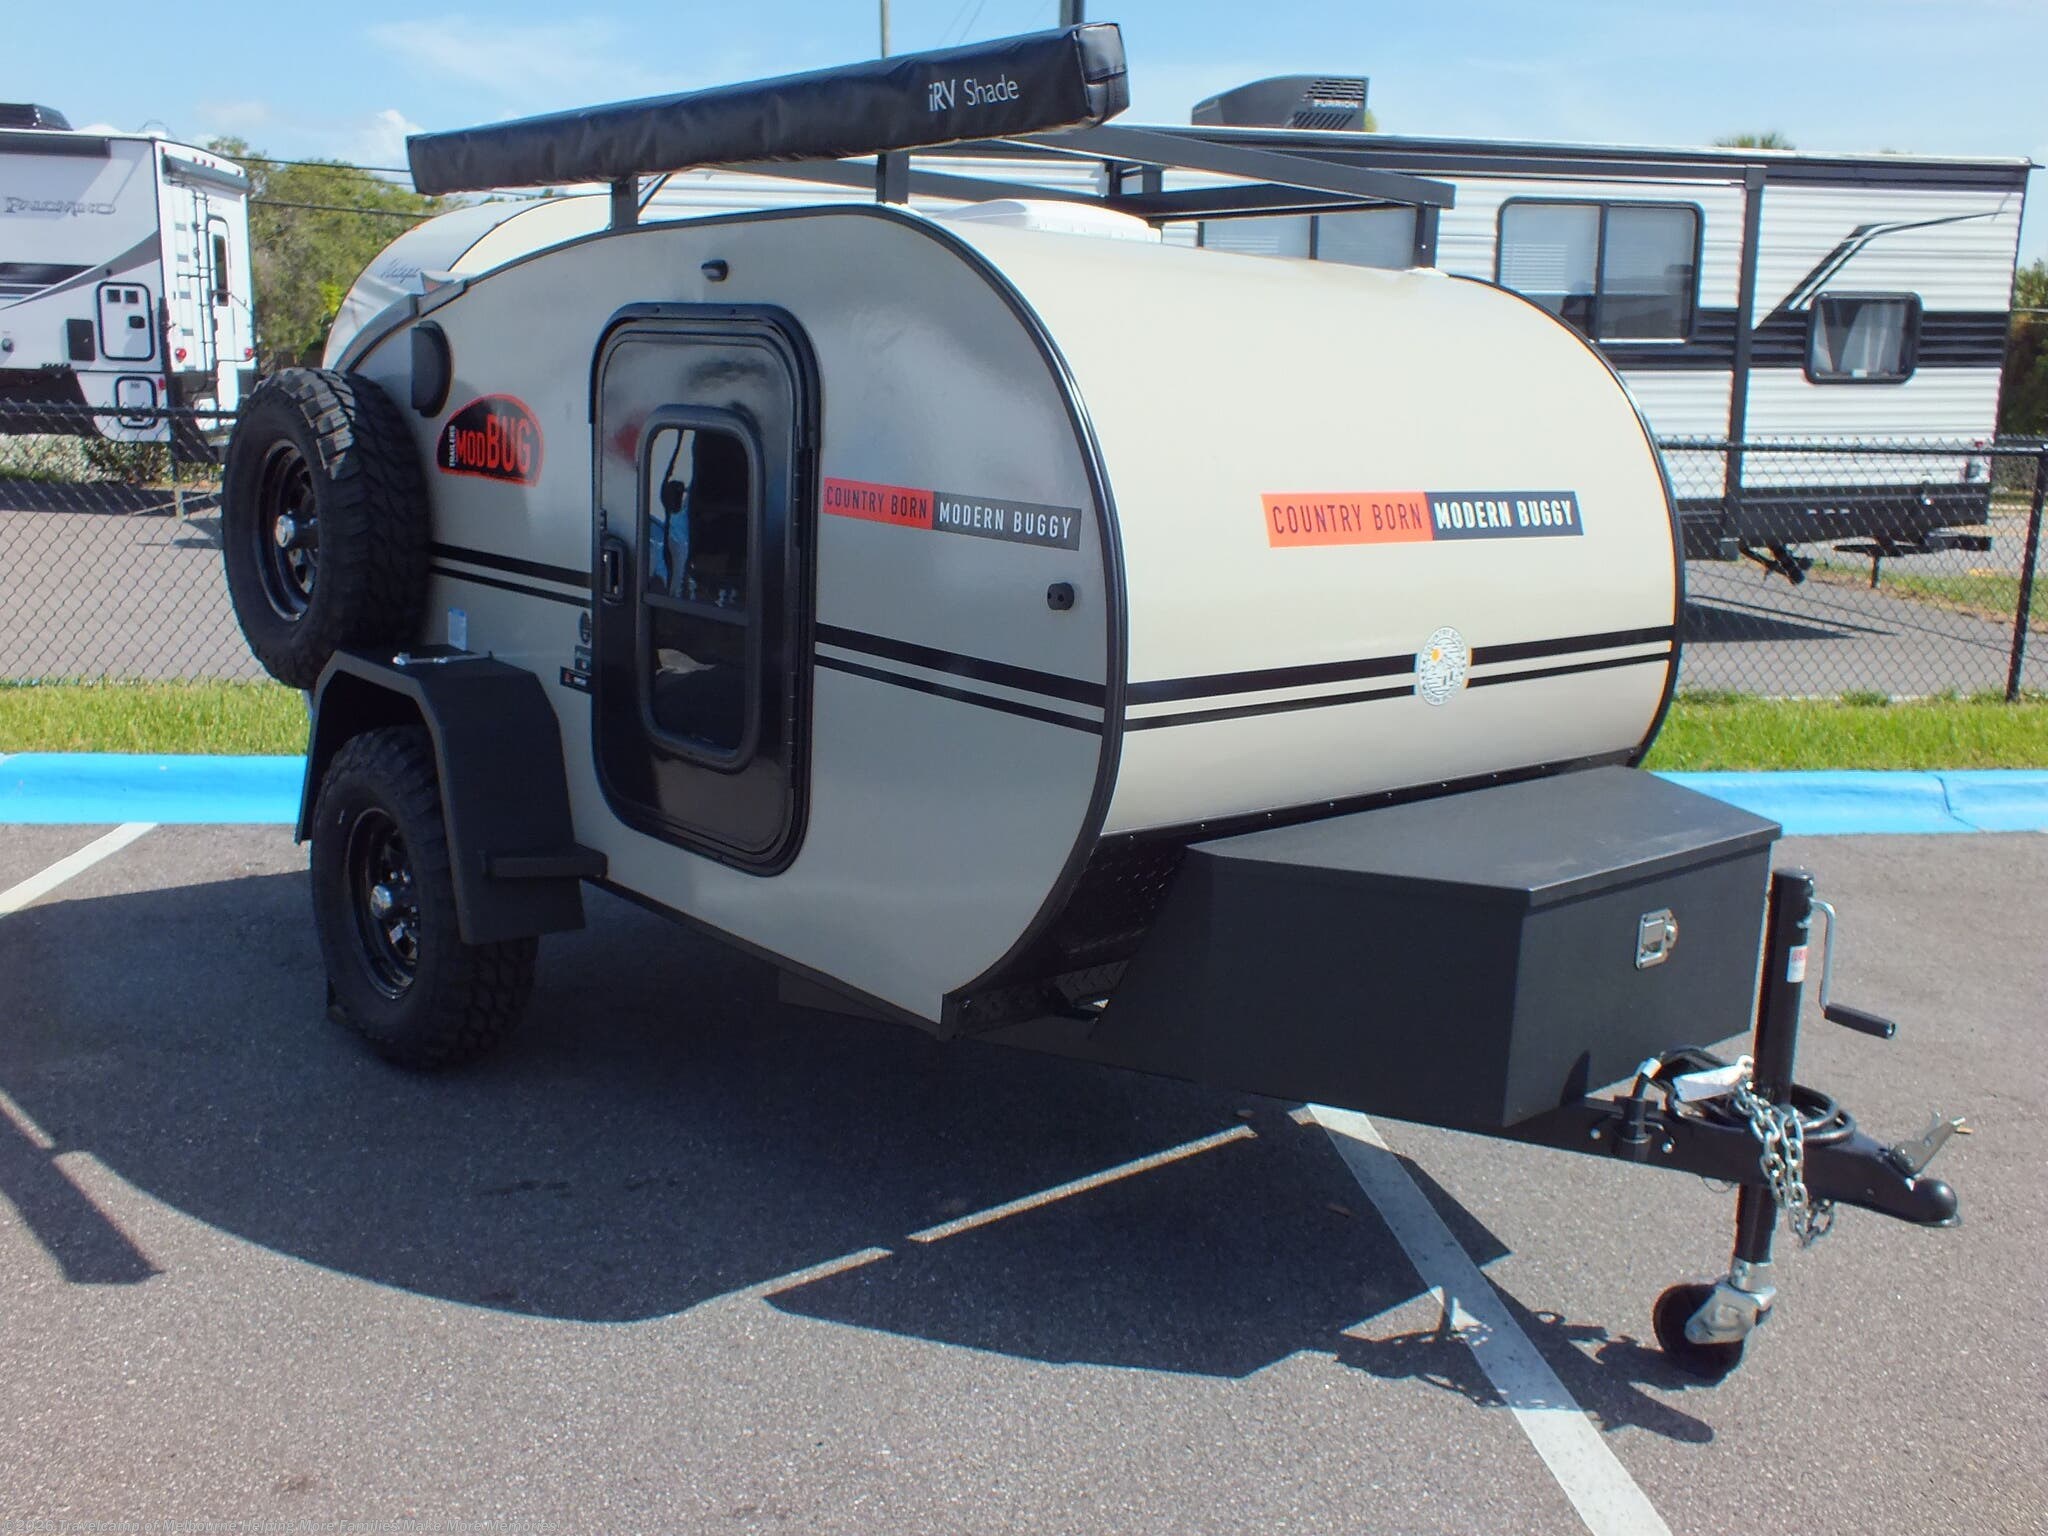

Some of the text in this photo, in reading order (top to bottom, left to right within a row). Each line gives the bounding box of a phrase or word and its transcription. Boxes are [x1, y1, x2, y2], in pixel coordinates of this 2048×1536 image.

[928, 73, 1020, 112] iRV Shade
[826, 486, 1072, 539] COUNTRY BORN MODERN BUGGY
[1272, 500, 1573, 534] COUNTRY BORN MODERN BUGGY
